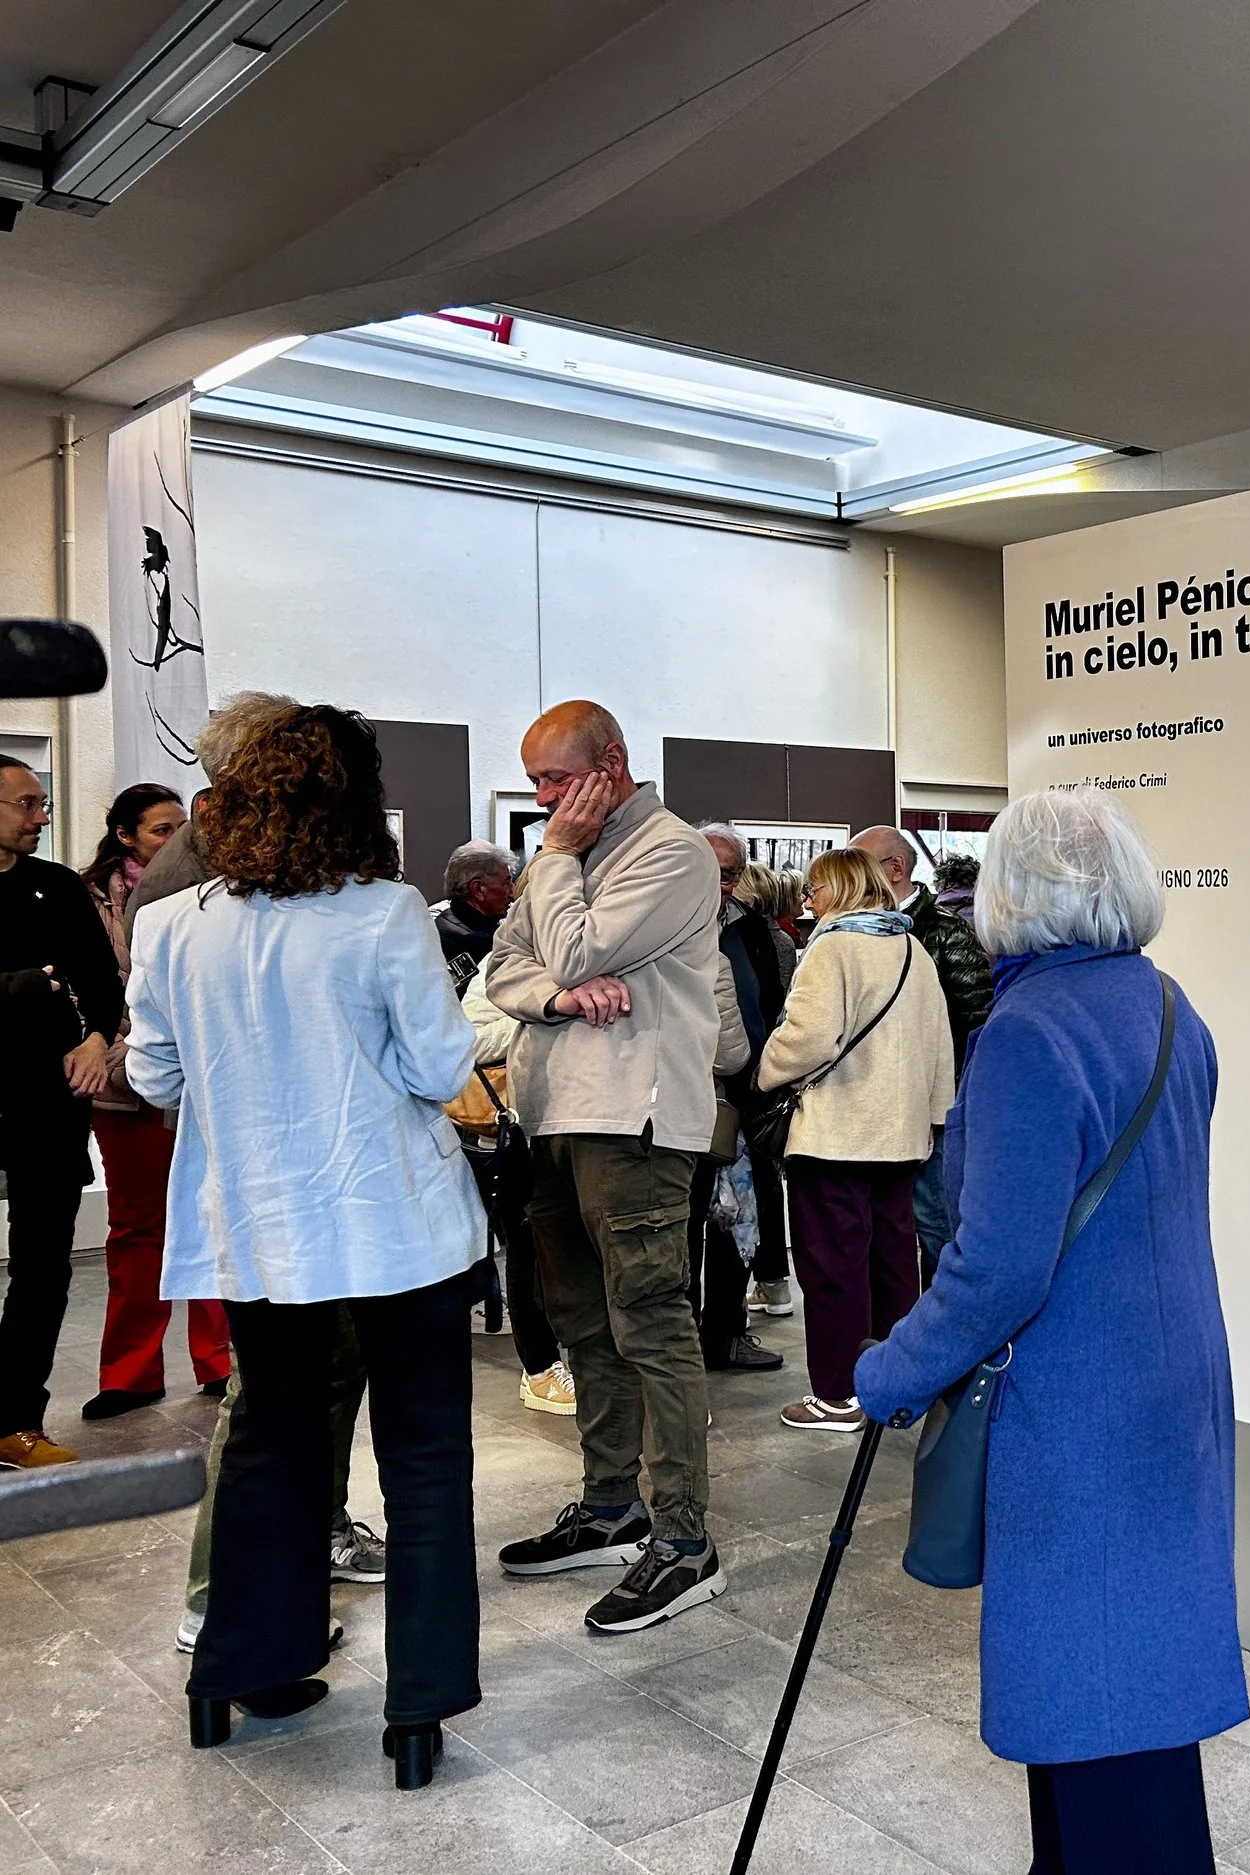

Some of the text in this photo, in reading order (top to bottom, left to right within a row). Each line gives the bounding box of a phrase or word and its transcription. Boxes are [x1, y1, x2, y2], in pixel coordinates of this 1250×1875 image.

[1045, 585, 1145, 638] Muriel
[1046, 644, 1074, 680] in
[1084, 630, 1178, 675] cielo,
[1190, 621, 1222, 660] in
[1048, 716, 1224, 747] un universo fotografico
[1094, 774, 1136, 791] Federico
[1139, 772, 1167, 788] Crimi
[1156, 868, 1229, 888] UGNO 2026
